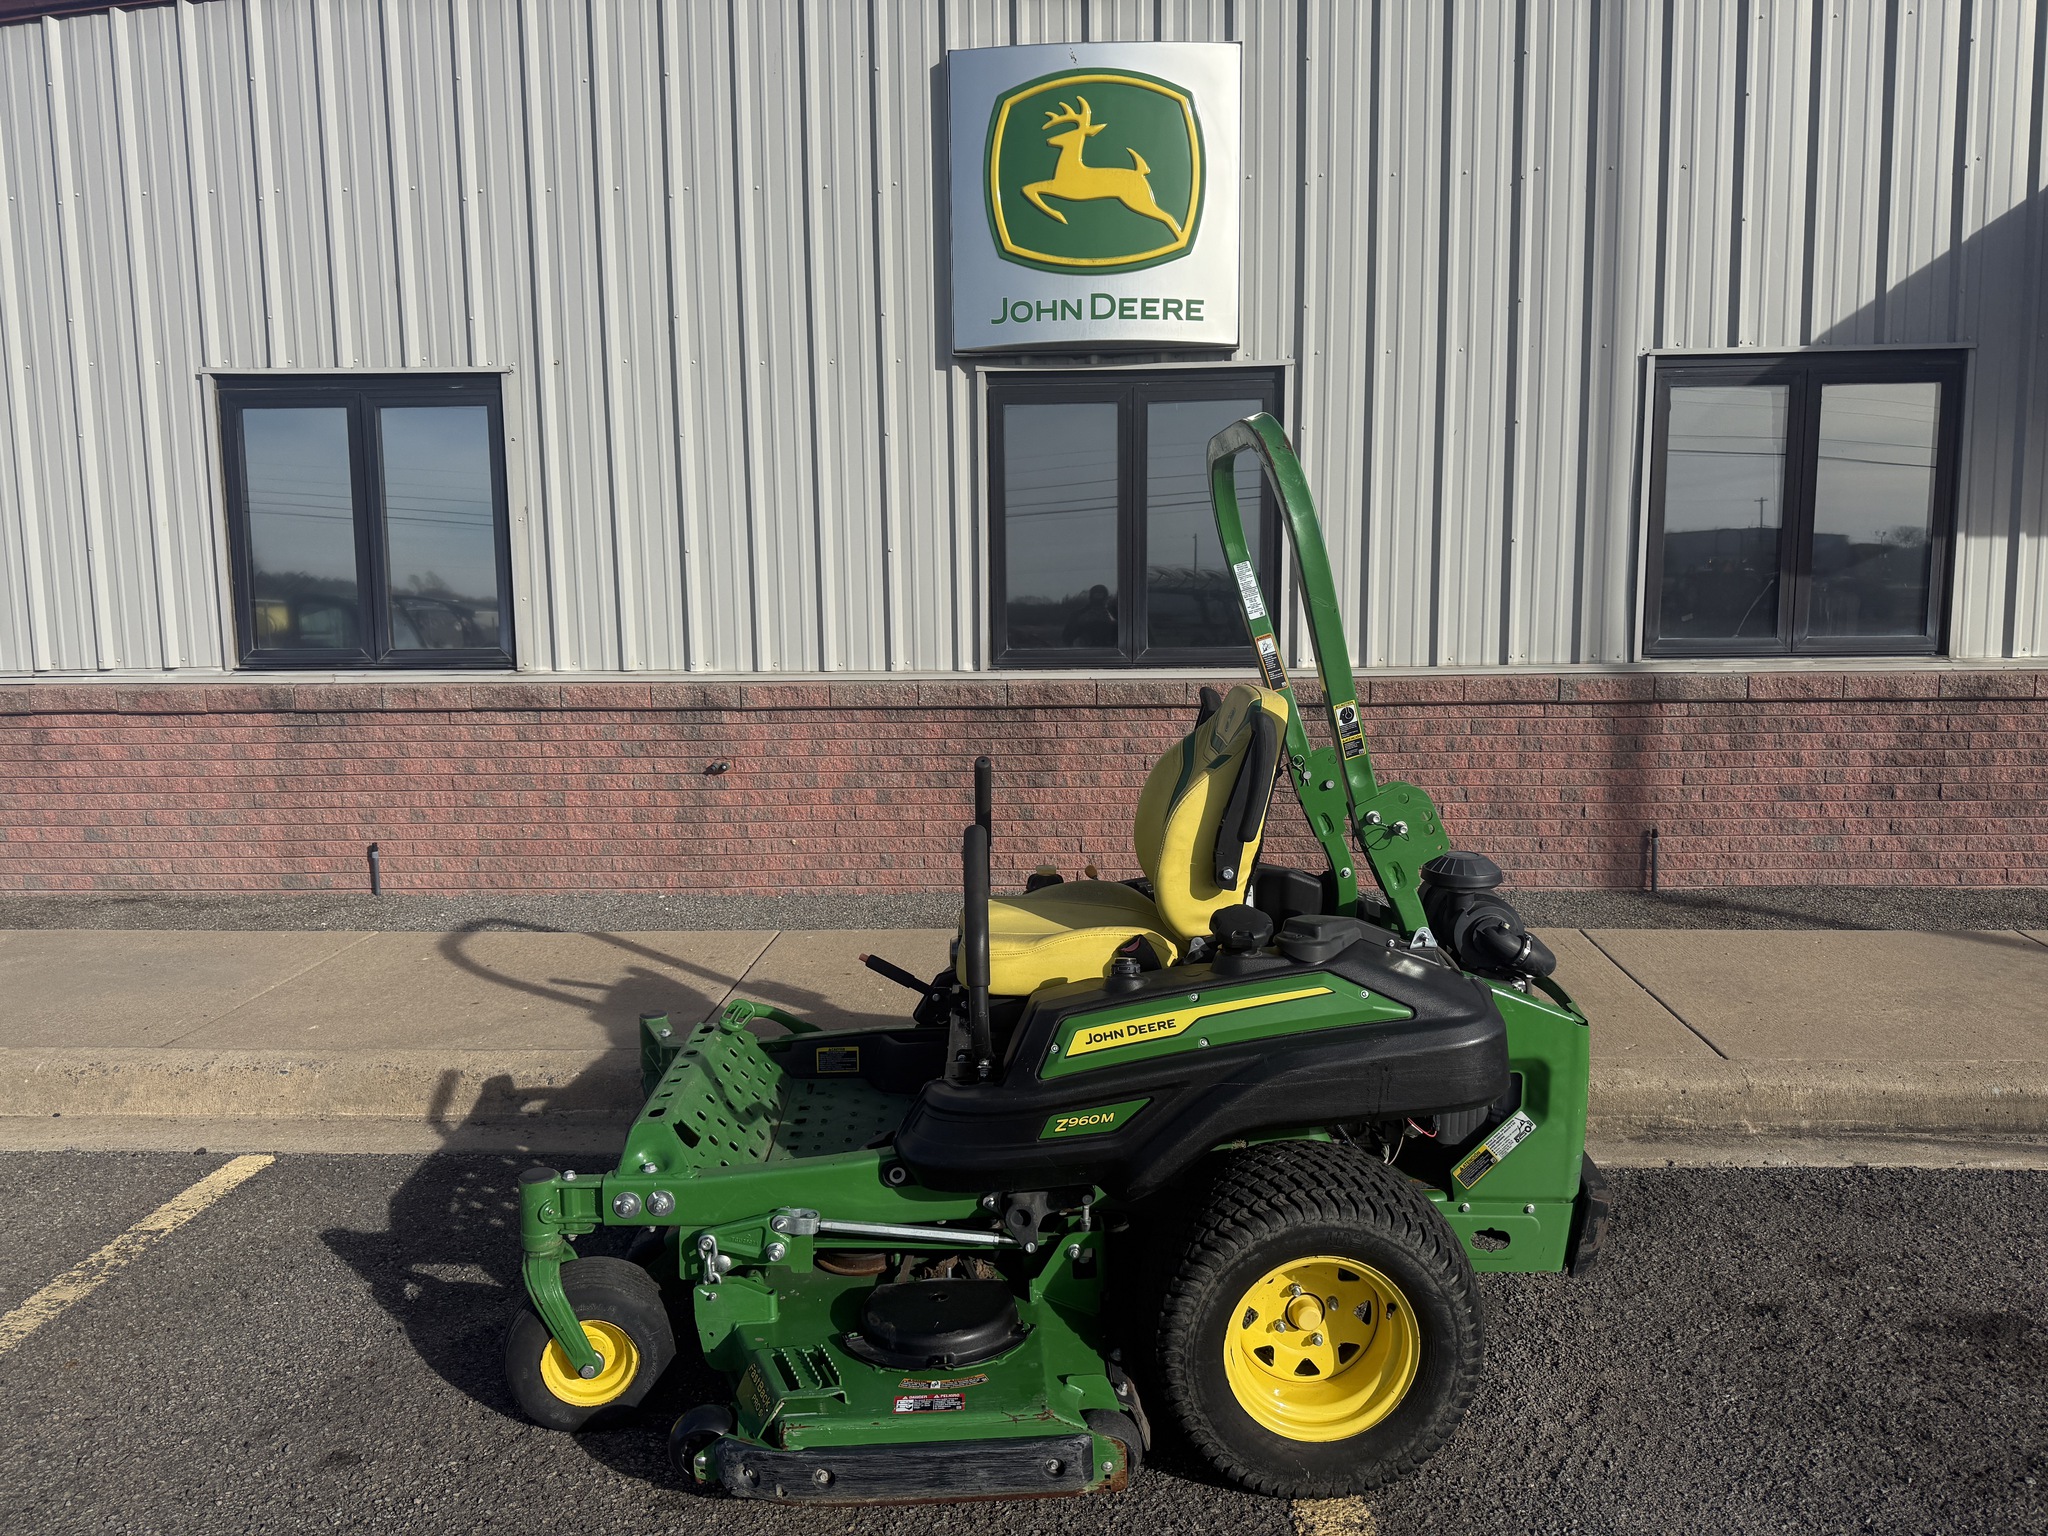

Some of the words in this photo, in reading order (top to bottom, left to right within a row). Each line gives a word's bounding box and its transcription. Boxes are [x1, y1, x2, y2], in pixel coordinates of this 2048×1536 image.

[991, 297, 1082, 324] JOHN
[1090, 293, 1205, 321] DEERE
[1085, 1028, 1125, 1045] JOHN
[1127, 1018, 1176, 1036] DEERE
[1054, 1112, 1115, 1132] Z960M
